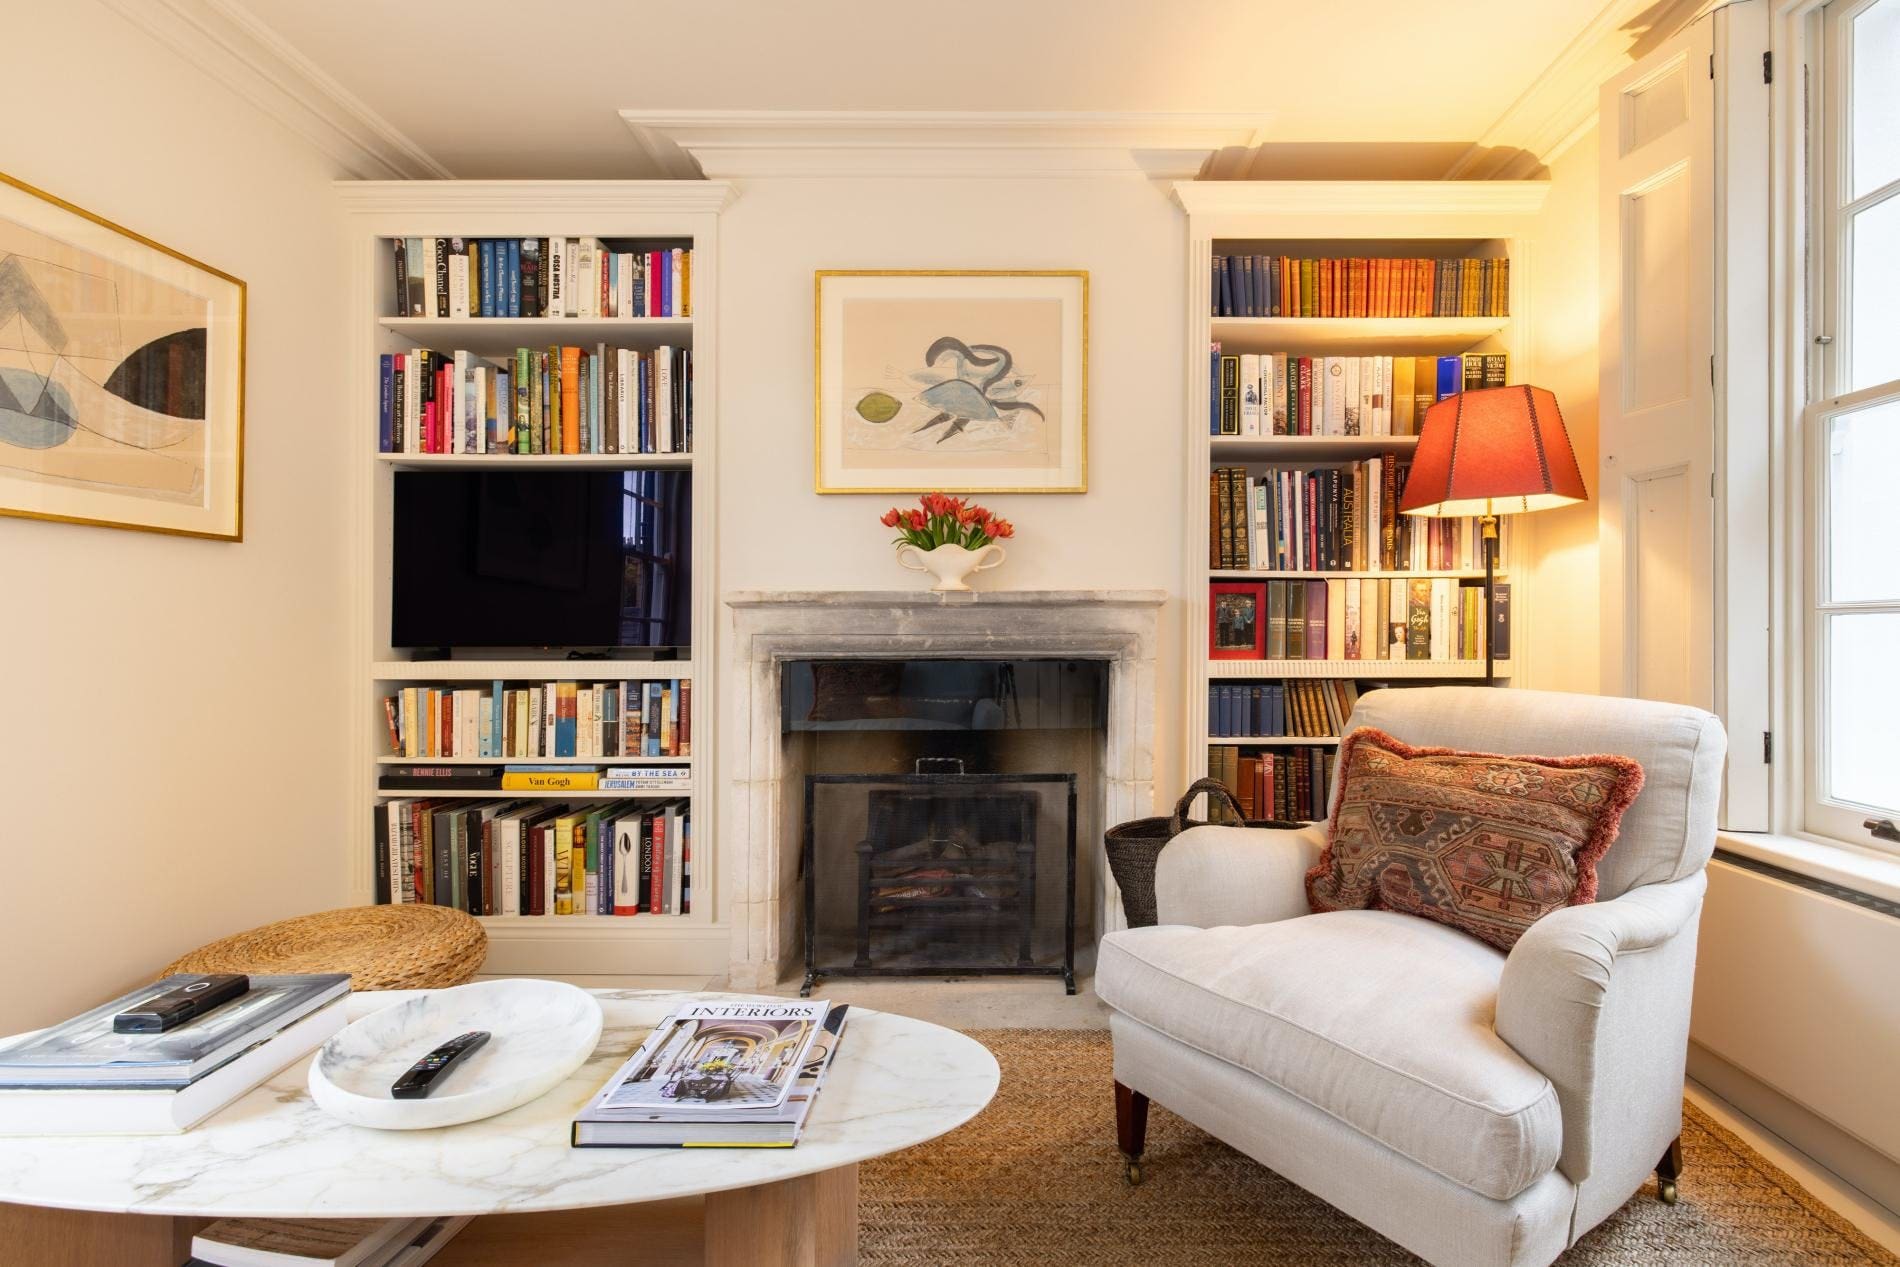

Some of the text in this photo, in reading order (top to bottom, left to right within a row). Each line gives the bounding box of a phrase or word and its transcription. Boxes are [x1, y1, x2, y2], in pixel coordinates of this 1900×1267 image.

[437, 239, 448, 295] Coco Chanel
[553, 254, 561, 272] COSA
[553, 273, 561, 300] NOSTRA
[1344, 487, 1354, 546] AUSTRALIA
[1415, 608, 1426, 616] Van
[1410, 614, 1429, 625] Gogh
[412, 768, 452, 777] RENNIE ELLIS
[529, 777, 571, 787] Van Gogh
[604, 780, 636, 789] JERUSALEM
[505, 840, 513, 897] SCULPTURE
[691, 1007, 814, 1017] INTERIORS
